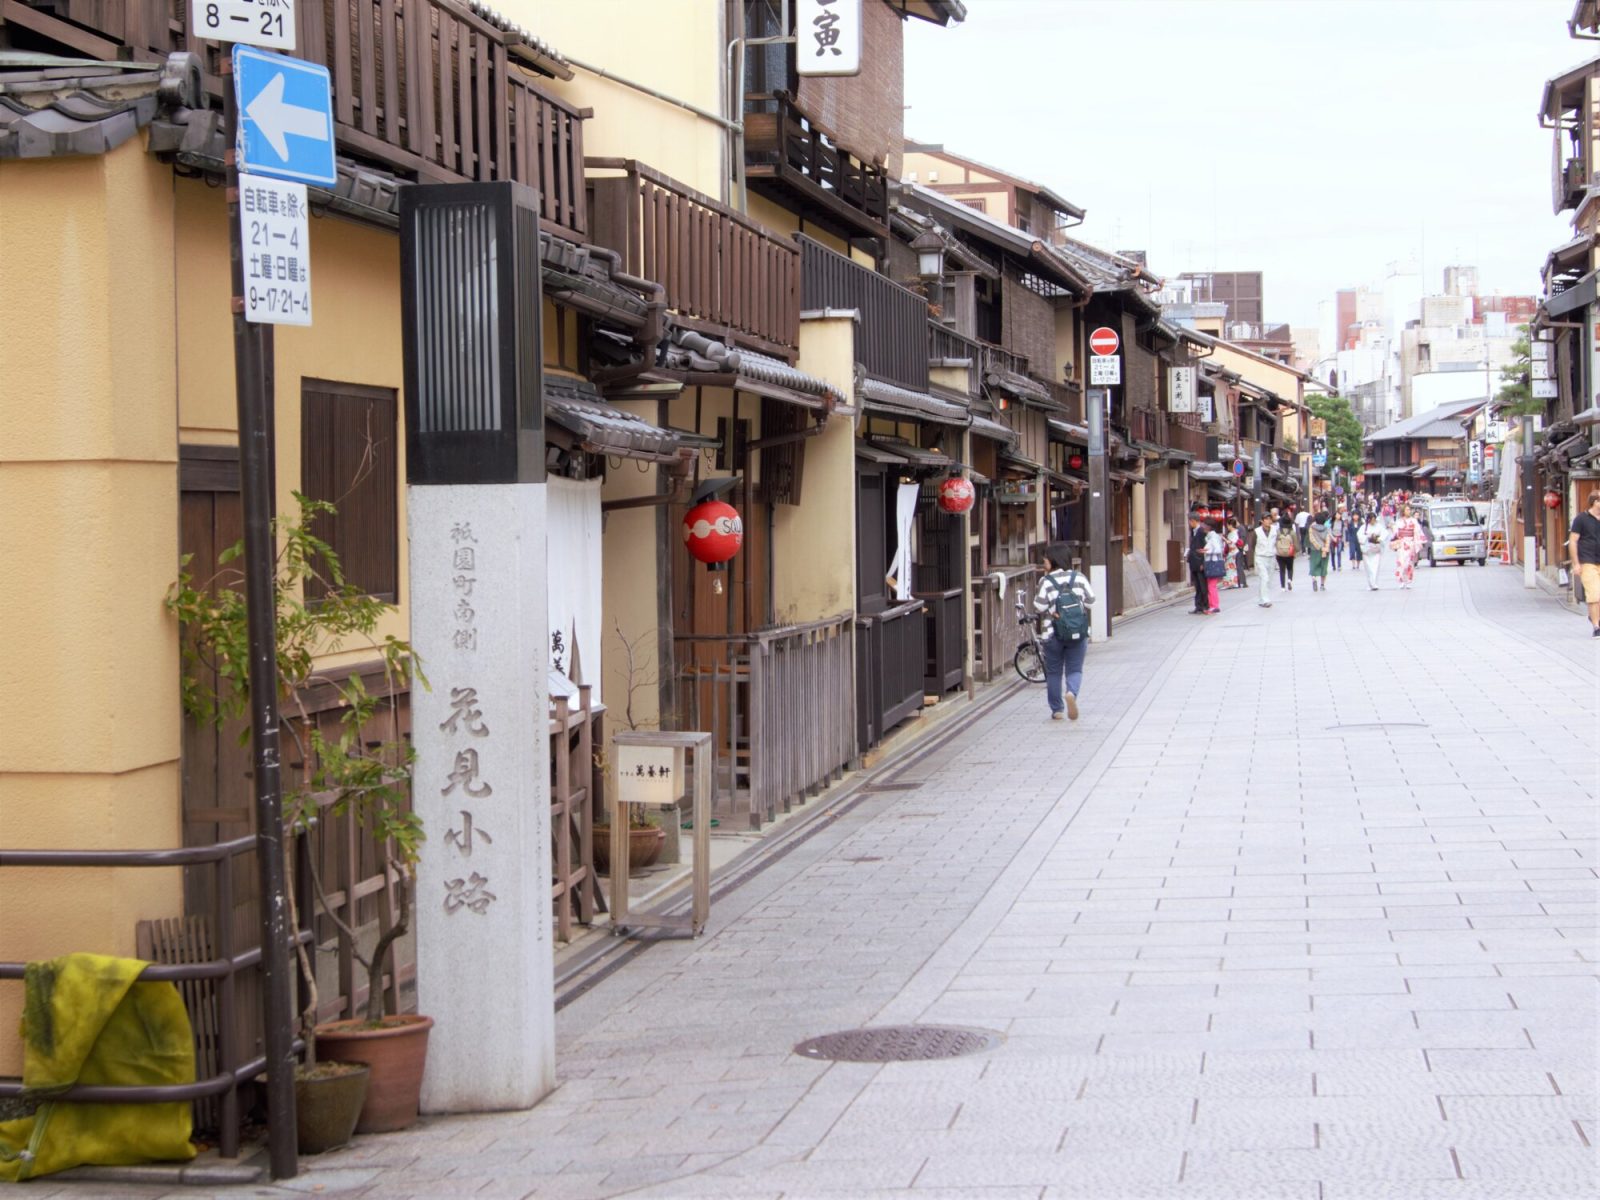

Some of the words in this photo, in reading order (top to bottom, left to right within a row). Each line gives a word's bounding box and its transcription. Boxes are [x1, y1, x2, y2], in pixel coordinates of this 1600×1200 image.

[812, 0, 843, 57] 寅
[244, 186, 306, 219] 自転車を除く
[439, 687, 497, 916] 花見小路
